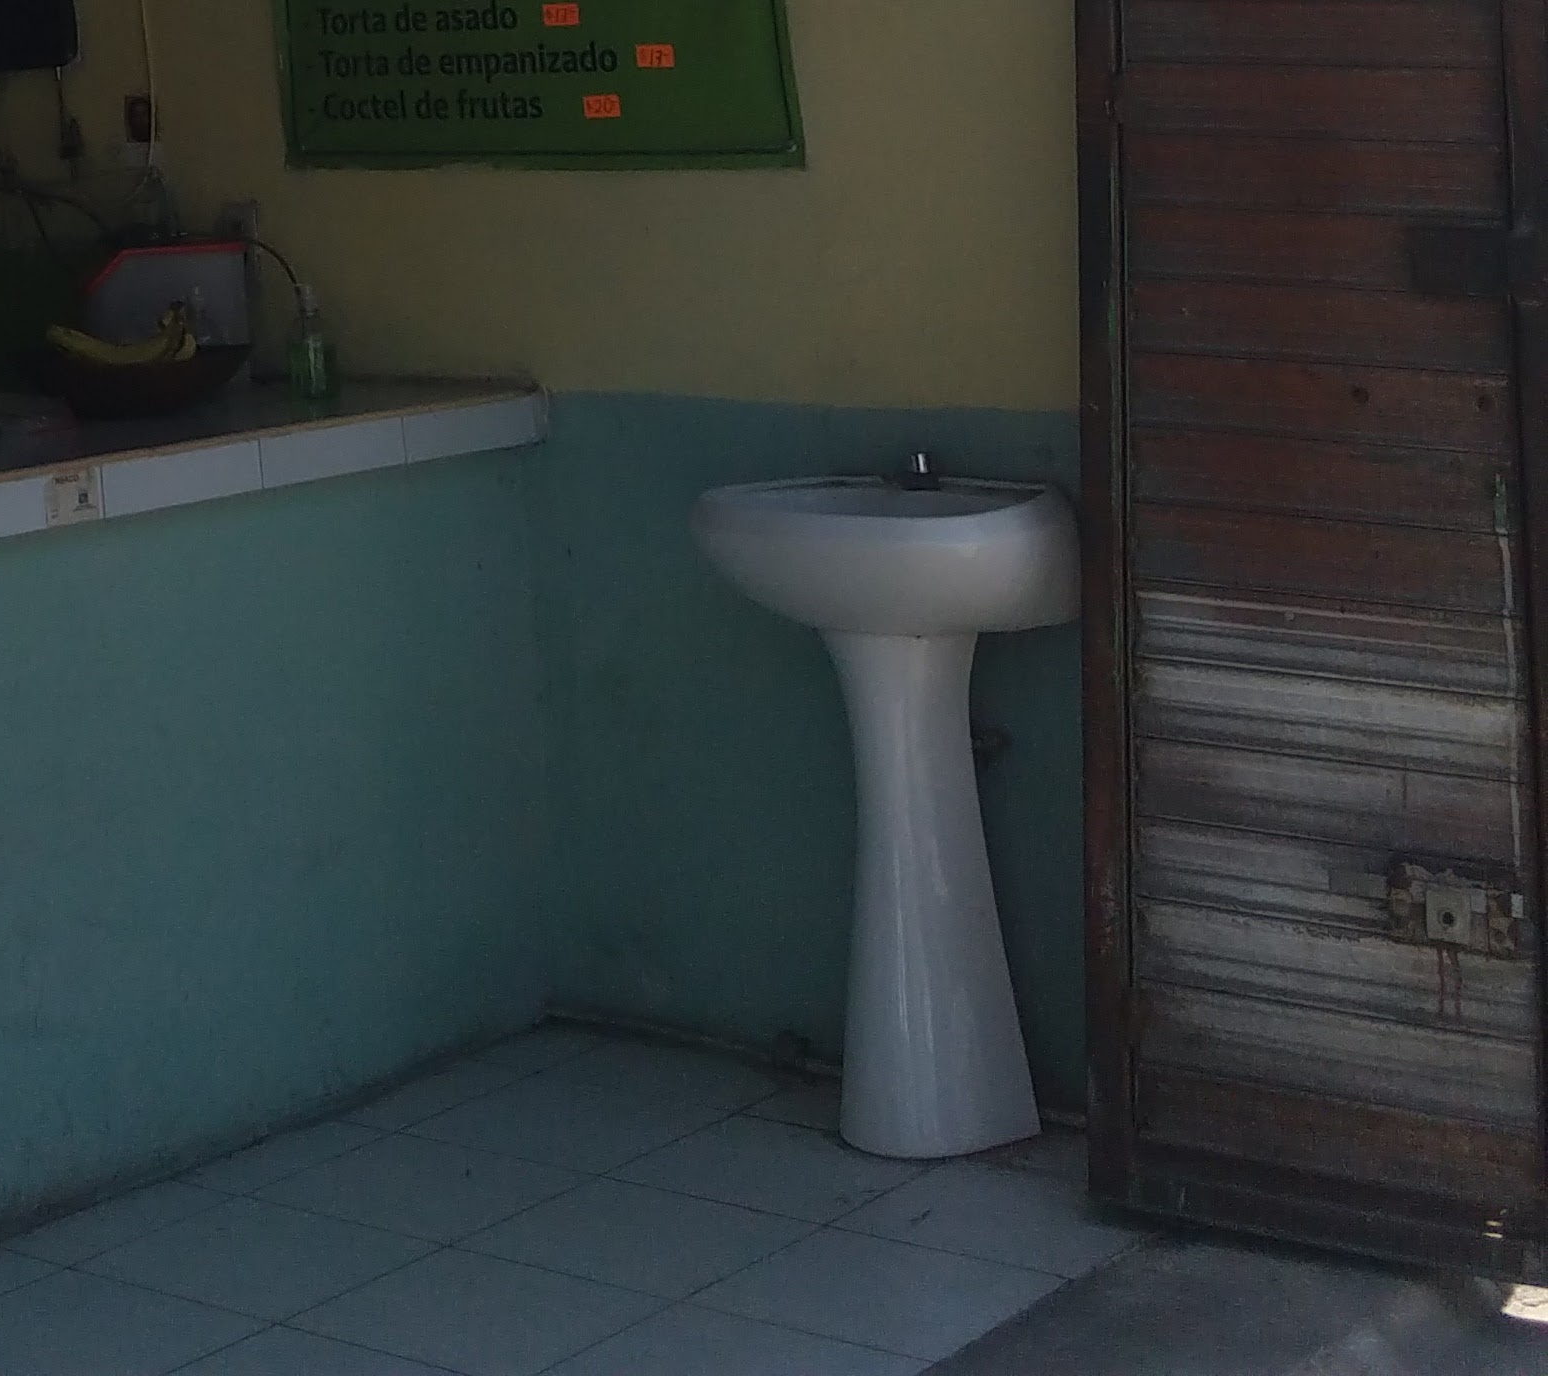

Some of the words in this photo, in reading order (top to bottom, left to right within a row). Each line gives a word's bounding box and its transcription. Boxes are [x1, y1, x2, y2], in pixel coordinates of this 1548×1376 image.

[317, 6, 387, 34] Torta
[395, 1, 428, 32] de
[436, 0, 518, 31] asado
[319, 48, 389, 78] Torta
[398, 45, 432, 76] de
[439, 41, 618, 84] empanizado
[324, 90, 407, 120] Coctel
[415, 90, 449, 120] de
[457, 89, 544, 120] frutas
